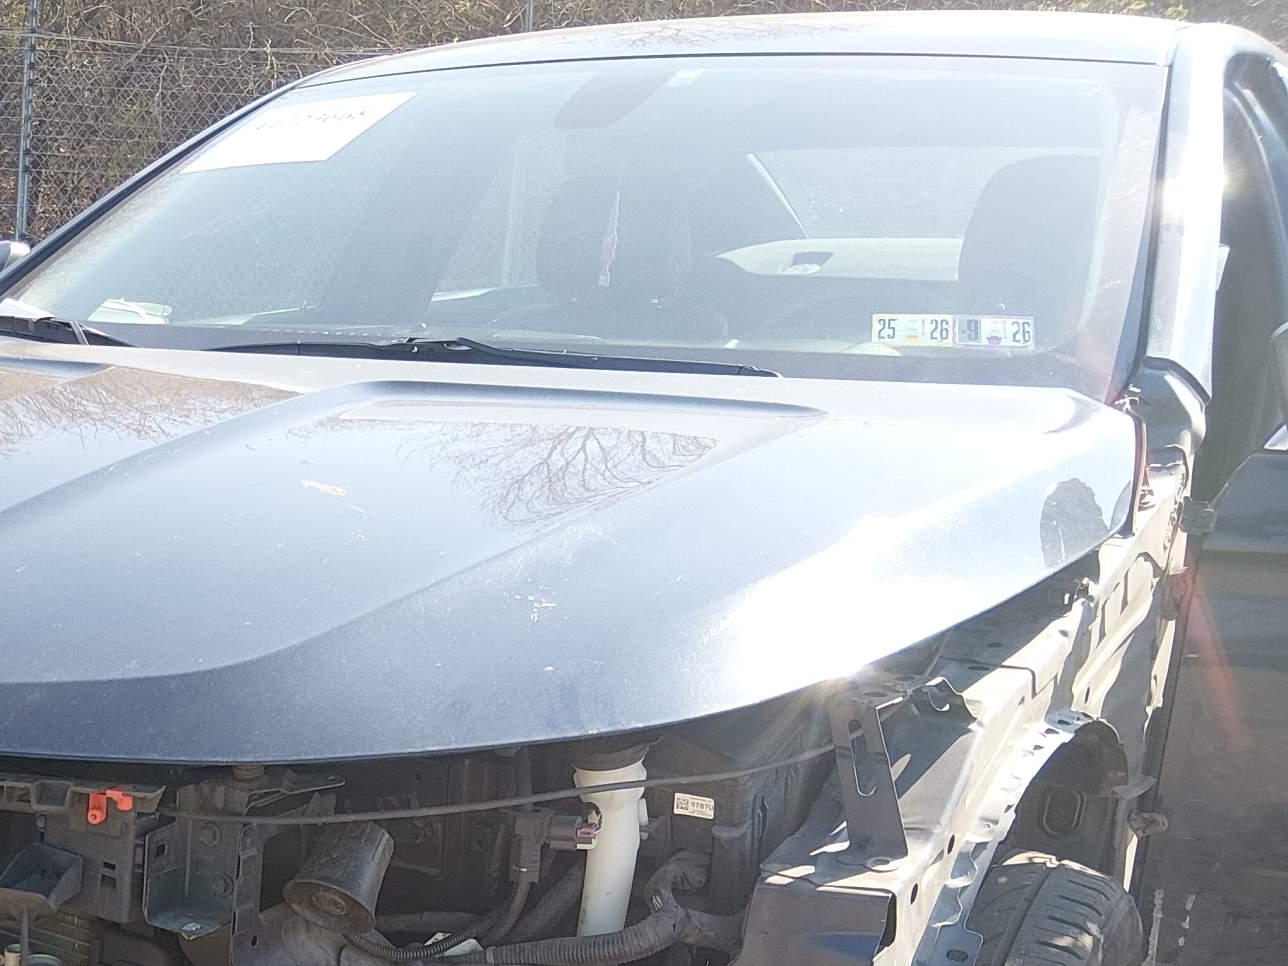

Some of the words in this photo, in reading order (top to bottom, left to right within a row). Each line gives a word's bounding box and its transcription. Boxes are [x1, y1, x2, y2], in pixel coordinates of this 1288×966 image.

[877, 318, 896, 339] 25
[930, 319, 949, 341] 26
[1012, 321, 1031, 343] 26
